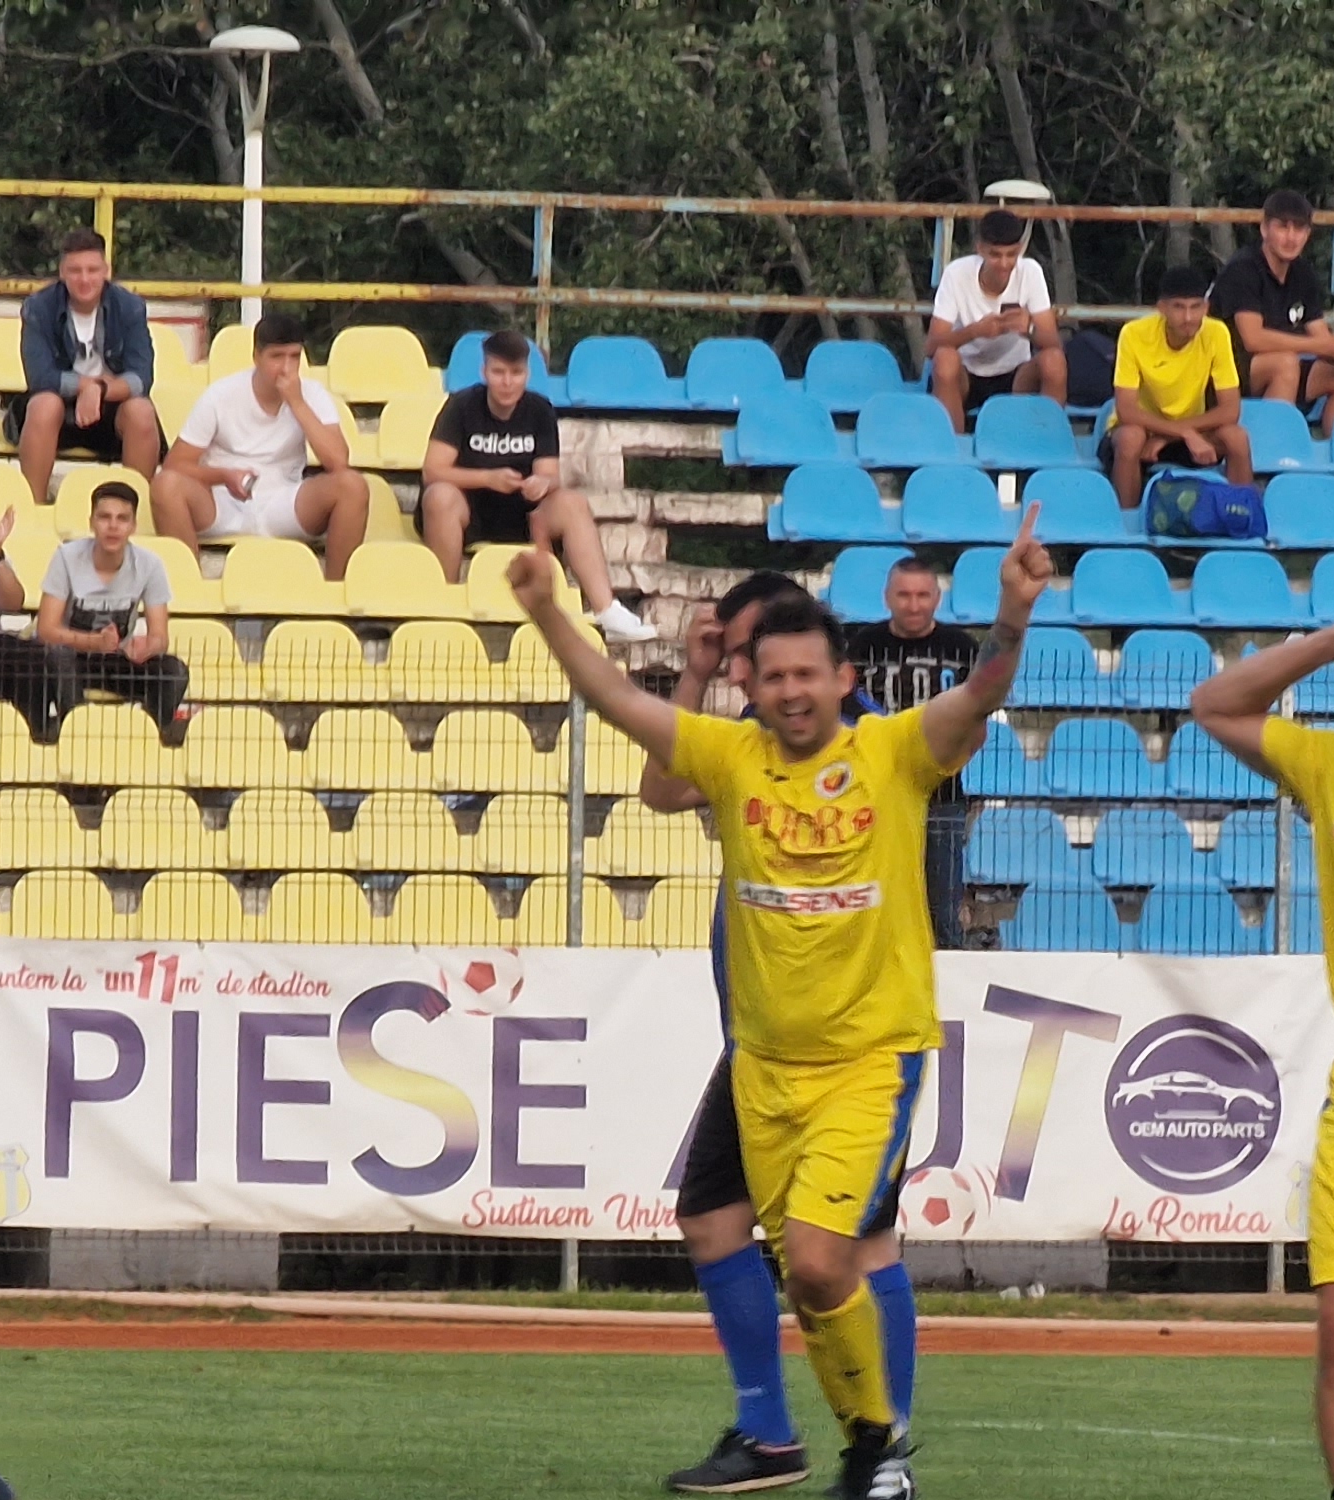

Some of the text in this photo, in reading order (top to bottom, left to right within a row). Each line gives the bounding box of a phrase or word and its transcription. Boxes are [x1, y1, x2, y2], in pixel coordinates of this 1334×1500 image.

[469, 432, 536, 454] adidas
[61, 964, 87, 991] la
[216, 970, 243, 995] de
[246, 970, 332, 997] stadion
[43, 980, 588, 1197] PIESE
[1129, 1121, 1266, 1138] OEM AUTO PARTS
[1101, 1195, 1271, 1242] La Romica
